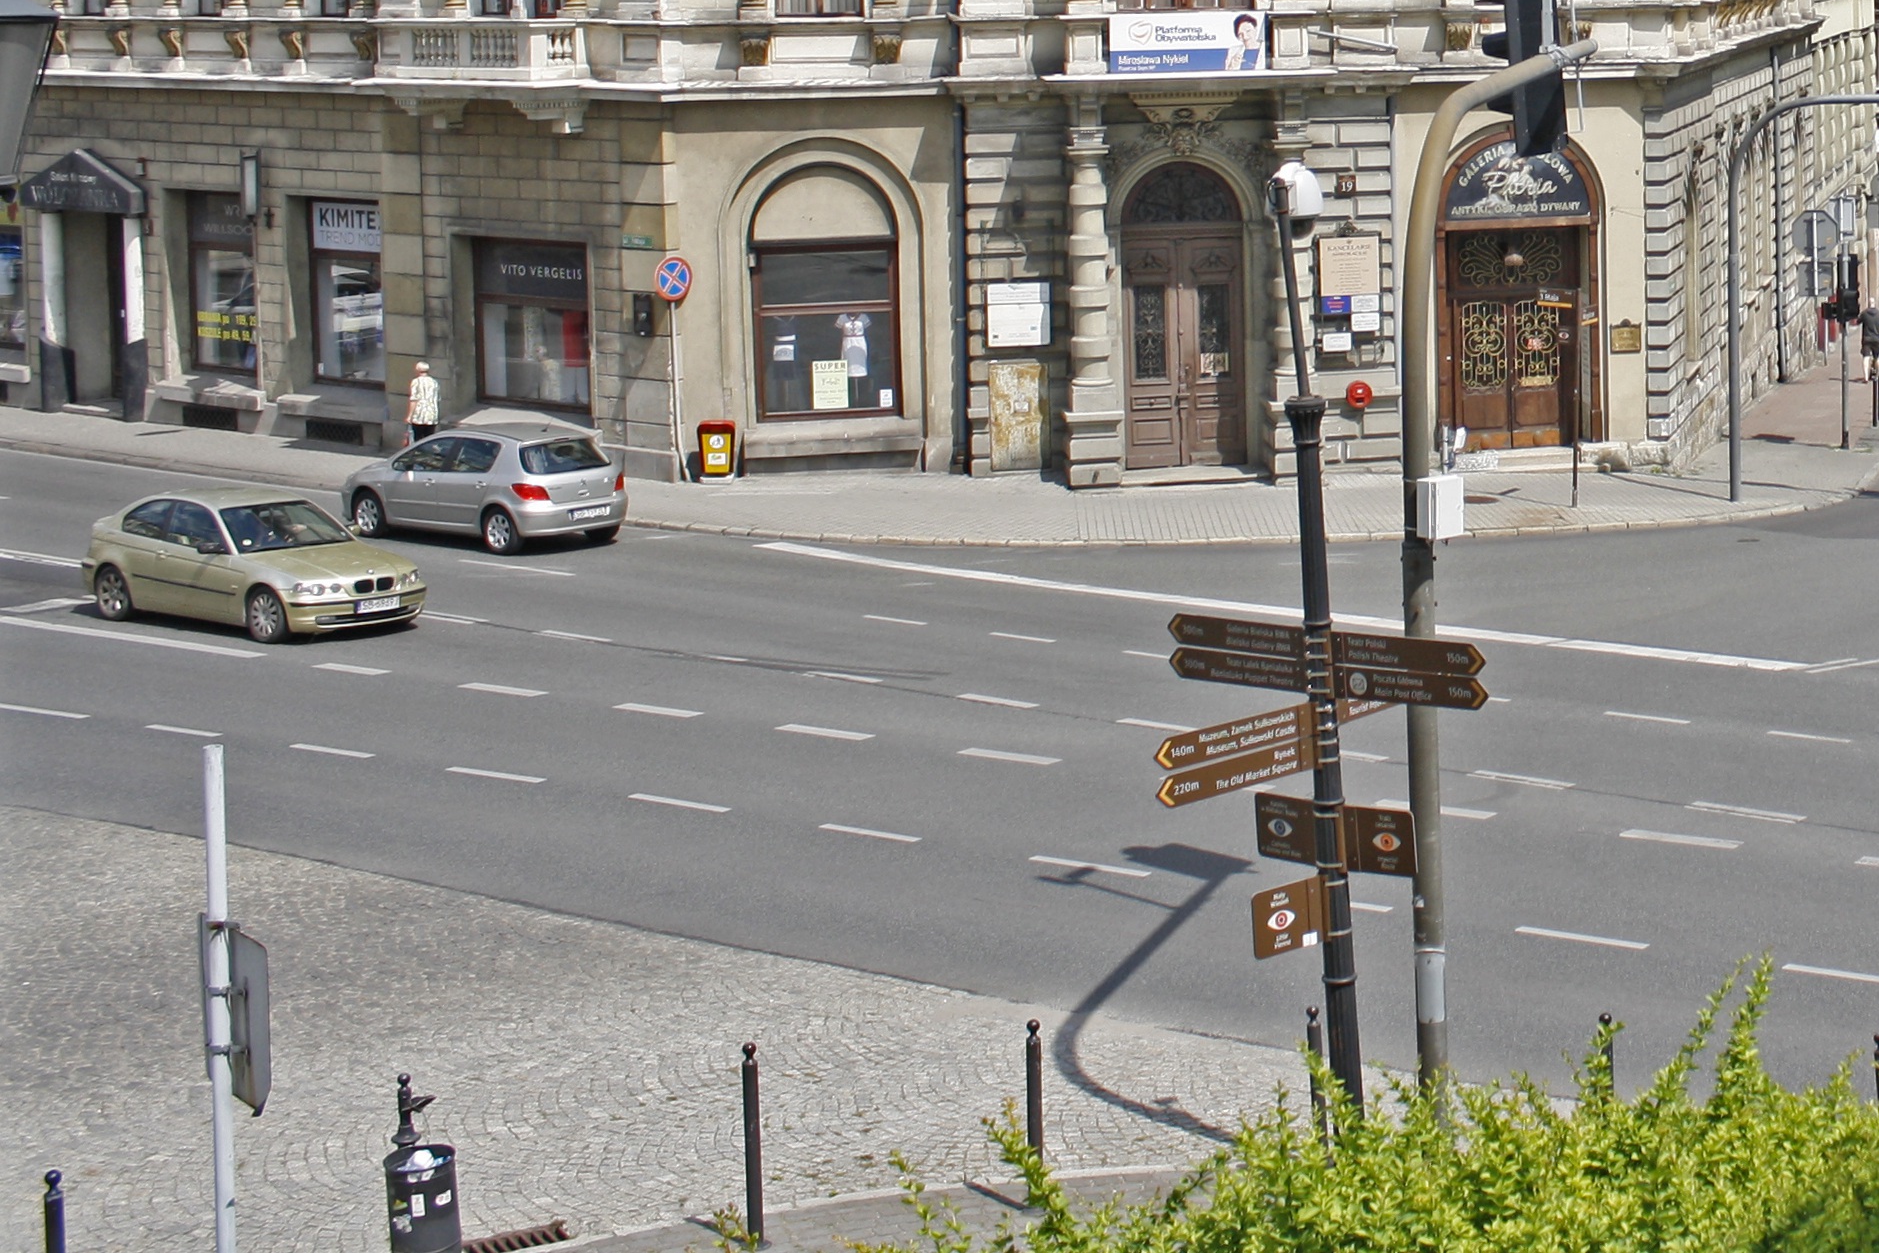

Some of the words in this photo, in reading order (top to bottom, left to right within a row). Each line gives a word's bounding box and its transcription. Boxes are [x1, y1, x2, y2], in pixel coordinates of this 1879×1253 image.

[1155, 25, 1202, 34] Platforma
[1155, 33, 1216, 43] Obywatelska
[1459, 145, 1505, 187] GALERIA
[1341, 181, 1353, 192] 19
[1540, 201, 1580, 212] DYWANY
[319, 229, 354, 246] TREND
[500, 264, 526, 276] VITO
[814, 362, 846, 371] SUPER
[1365, 638, 1386, 648] Polski
[1348, 650, 1370, 660] Polish
[1372, 652, 1398, 663] Theatre
[1446, 652, 1469, 664] 150m
[1373, 674, 1397, 684] Poczta
[1374, 688, 1393, 697] Main
[1394, 689, 1410, 698] Post
[1411, 690, 1432, 701] Office
[1448, 687, 1472, 699] 150m
[1198, 729, 1230, 743] Muzeum,
[1231, 722, 1253, 736] Zamek
[1205, 741, 1238, 756] Museum,
[1275, 725, 1297, 737] Castle
[1170, 745, 1195, 758] 140m
[1273, 747, 1295, 761] Rynek
[1216, 779, 1229, 790] The
[1230, 774, 1244, 786] Old
[1245, 767, 1271, 782] Market
[1271, 760, 1297, 776] Square
[1173, 781, 1199, 796] 220m
